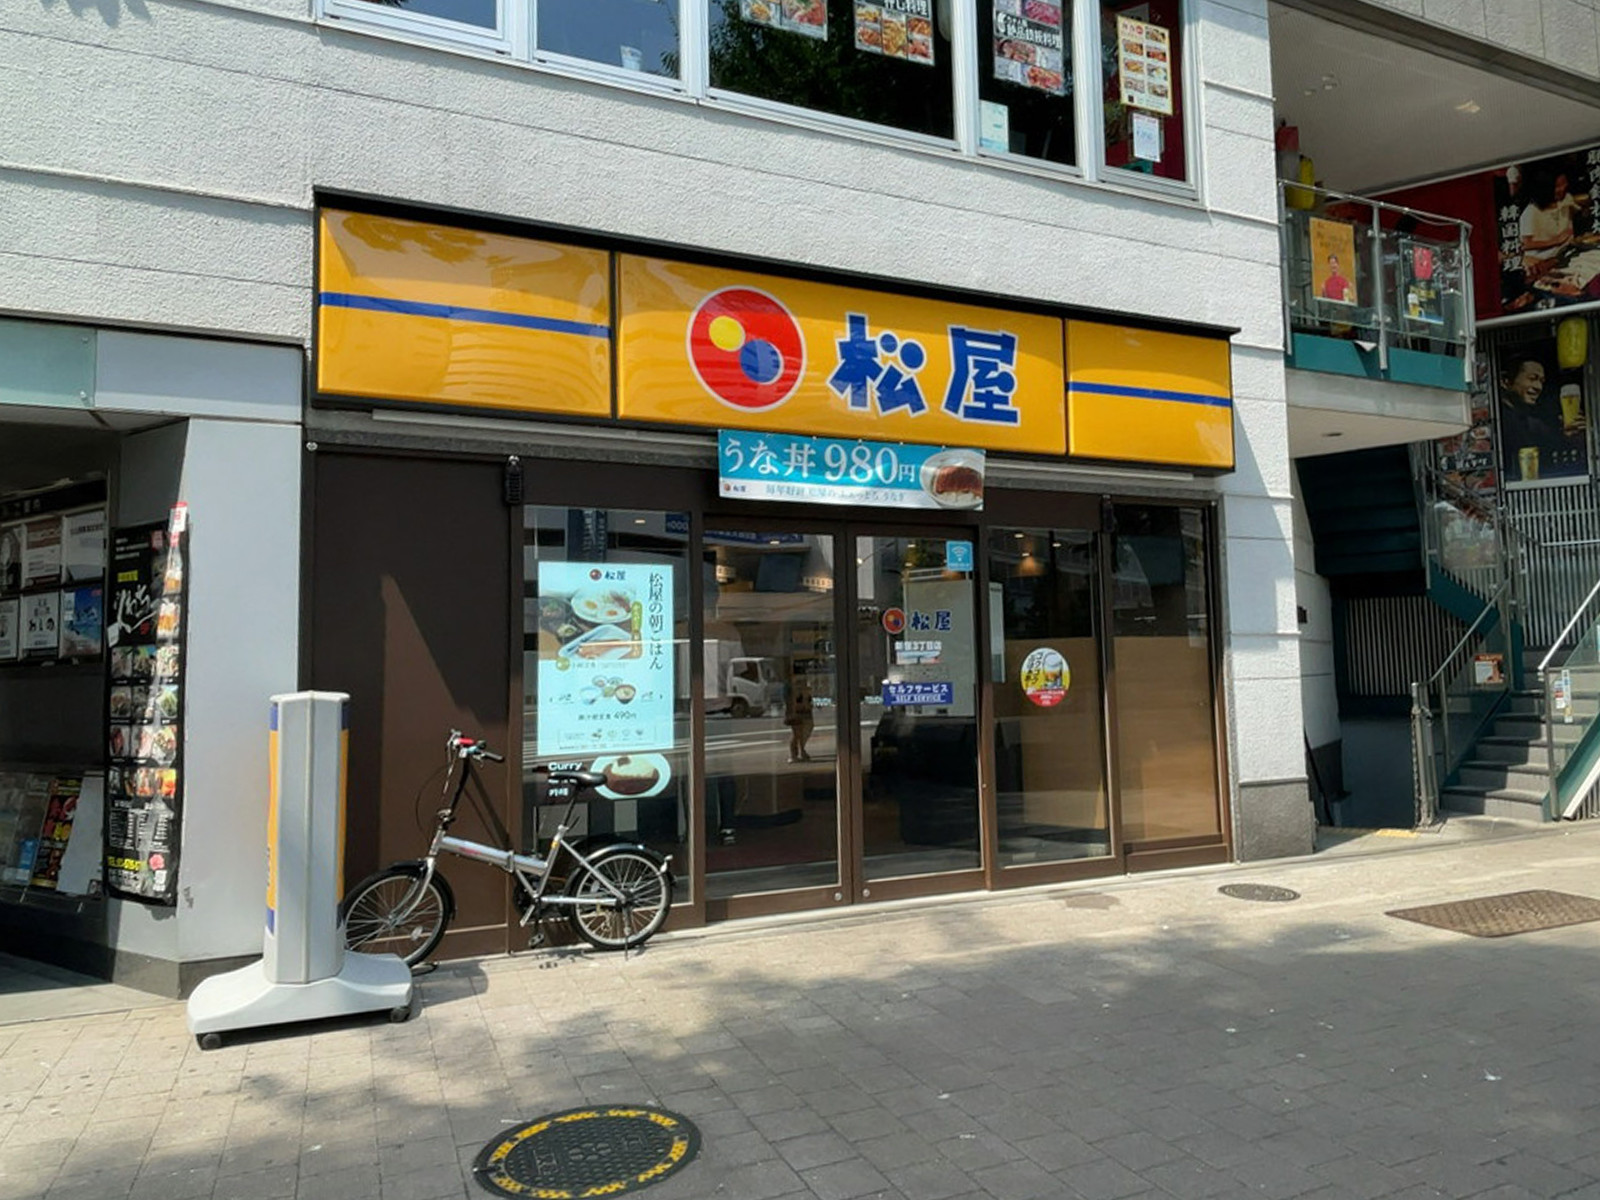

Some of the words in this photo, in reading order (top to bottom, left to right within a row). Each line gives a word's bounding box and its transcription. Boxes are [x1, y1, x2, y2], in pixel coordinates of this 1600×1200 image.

[829, 313, 1020, 426] 松屋
[724, 438, 816, 478] うな丼
[824, 444, 916, 484] 980円
[604, 570, 626, 581] 松屋
[648, 572, 664, 670] 松屋の朝ごはん
[911, 609, 952, 631] 松屋
[888, 683, 949, 694] セルフサービス
[548, 762, 582, 772] Curry
